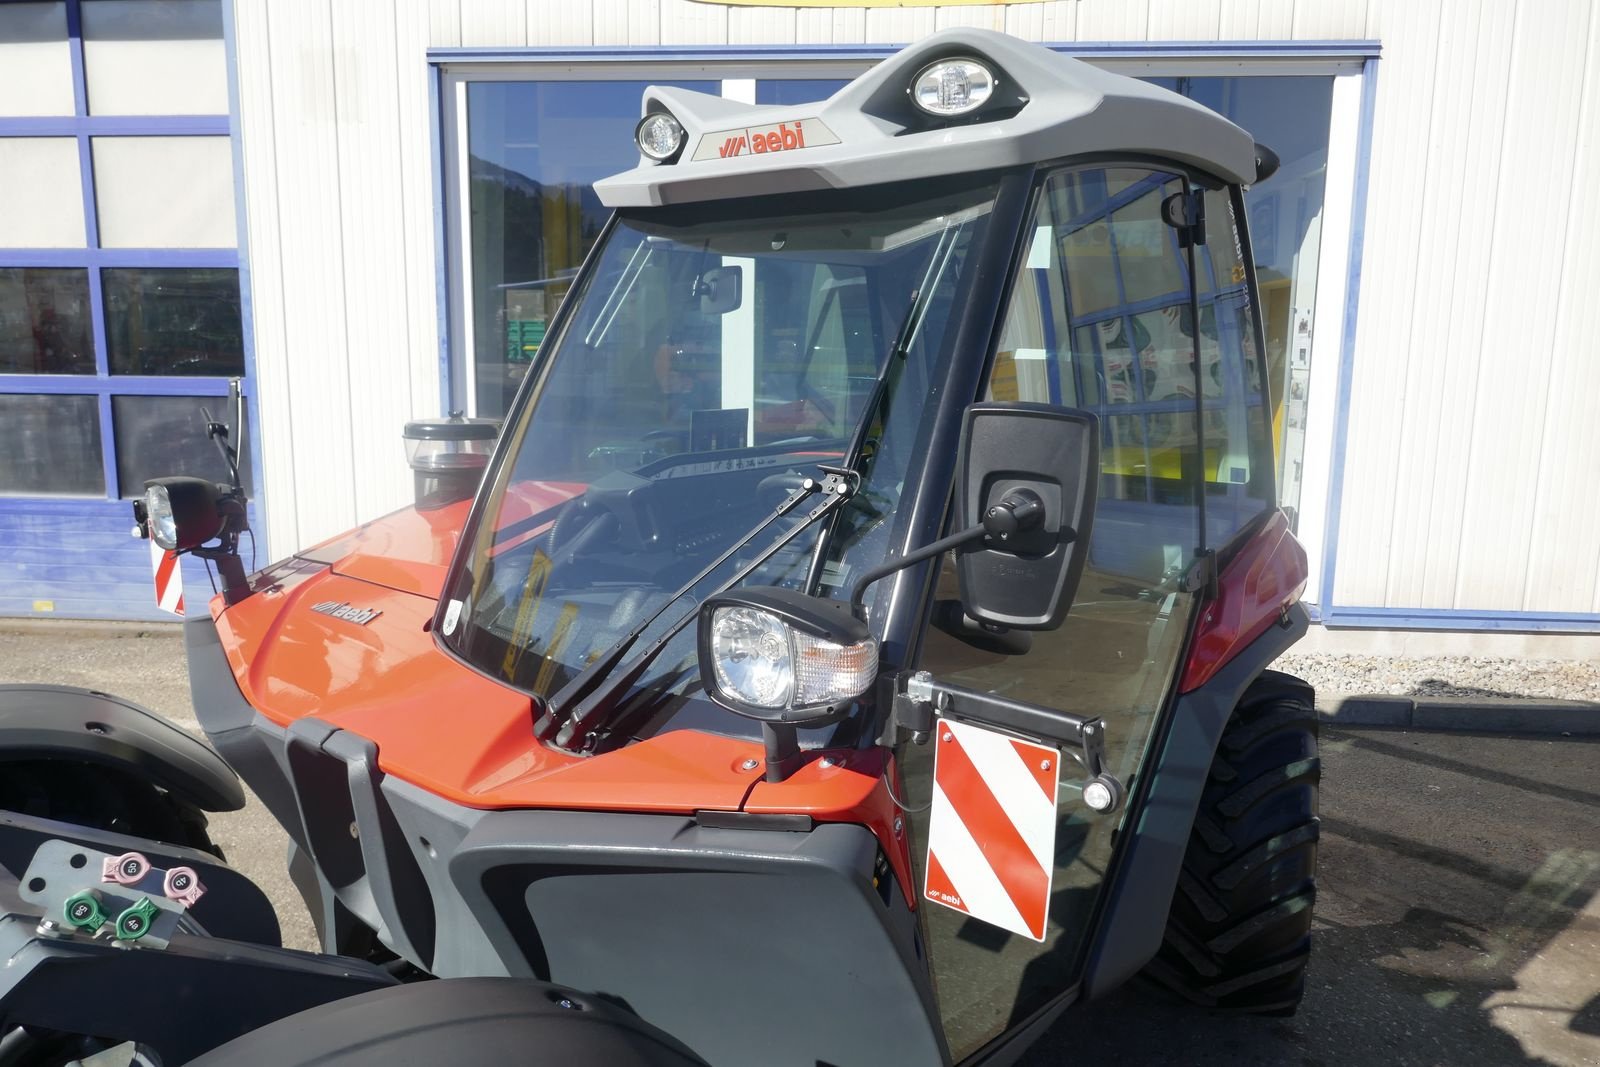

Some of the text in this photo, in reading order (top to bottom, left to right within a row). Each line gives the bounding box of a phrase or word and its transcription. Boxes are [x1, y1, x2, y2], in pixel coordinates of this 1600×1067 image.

[752, 122, 805, 154] aebi
[1232, 225, 1243, 260] aebi
[331, 602, 383, 626] aebi
[127, 862, 137, 874] 5b
[175, 876, 187, 888] 4b
[941, 893, 961, 906] aebi
[74, 905, 88, 917] 5a
[128, 919, 139, 930] 4a
